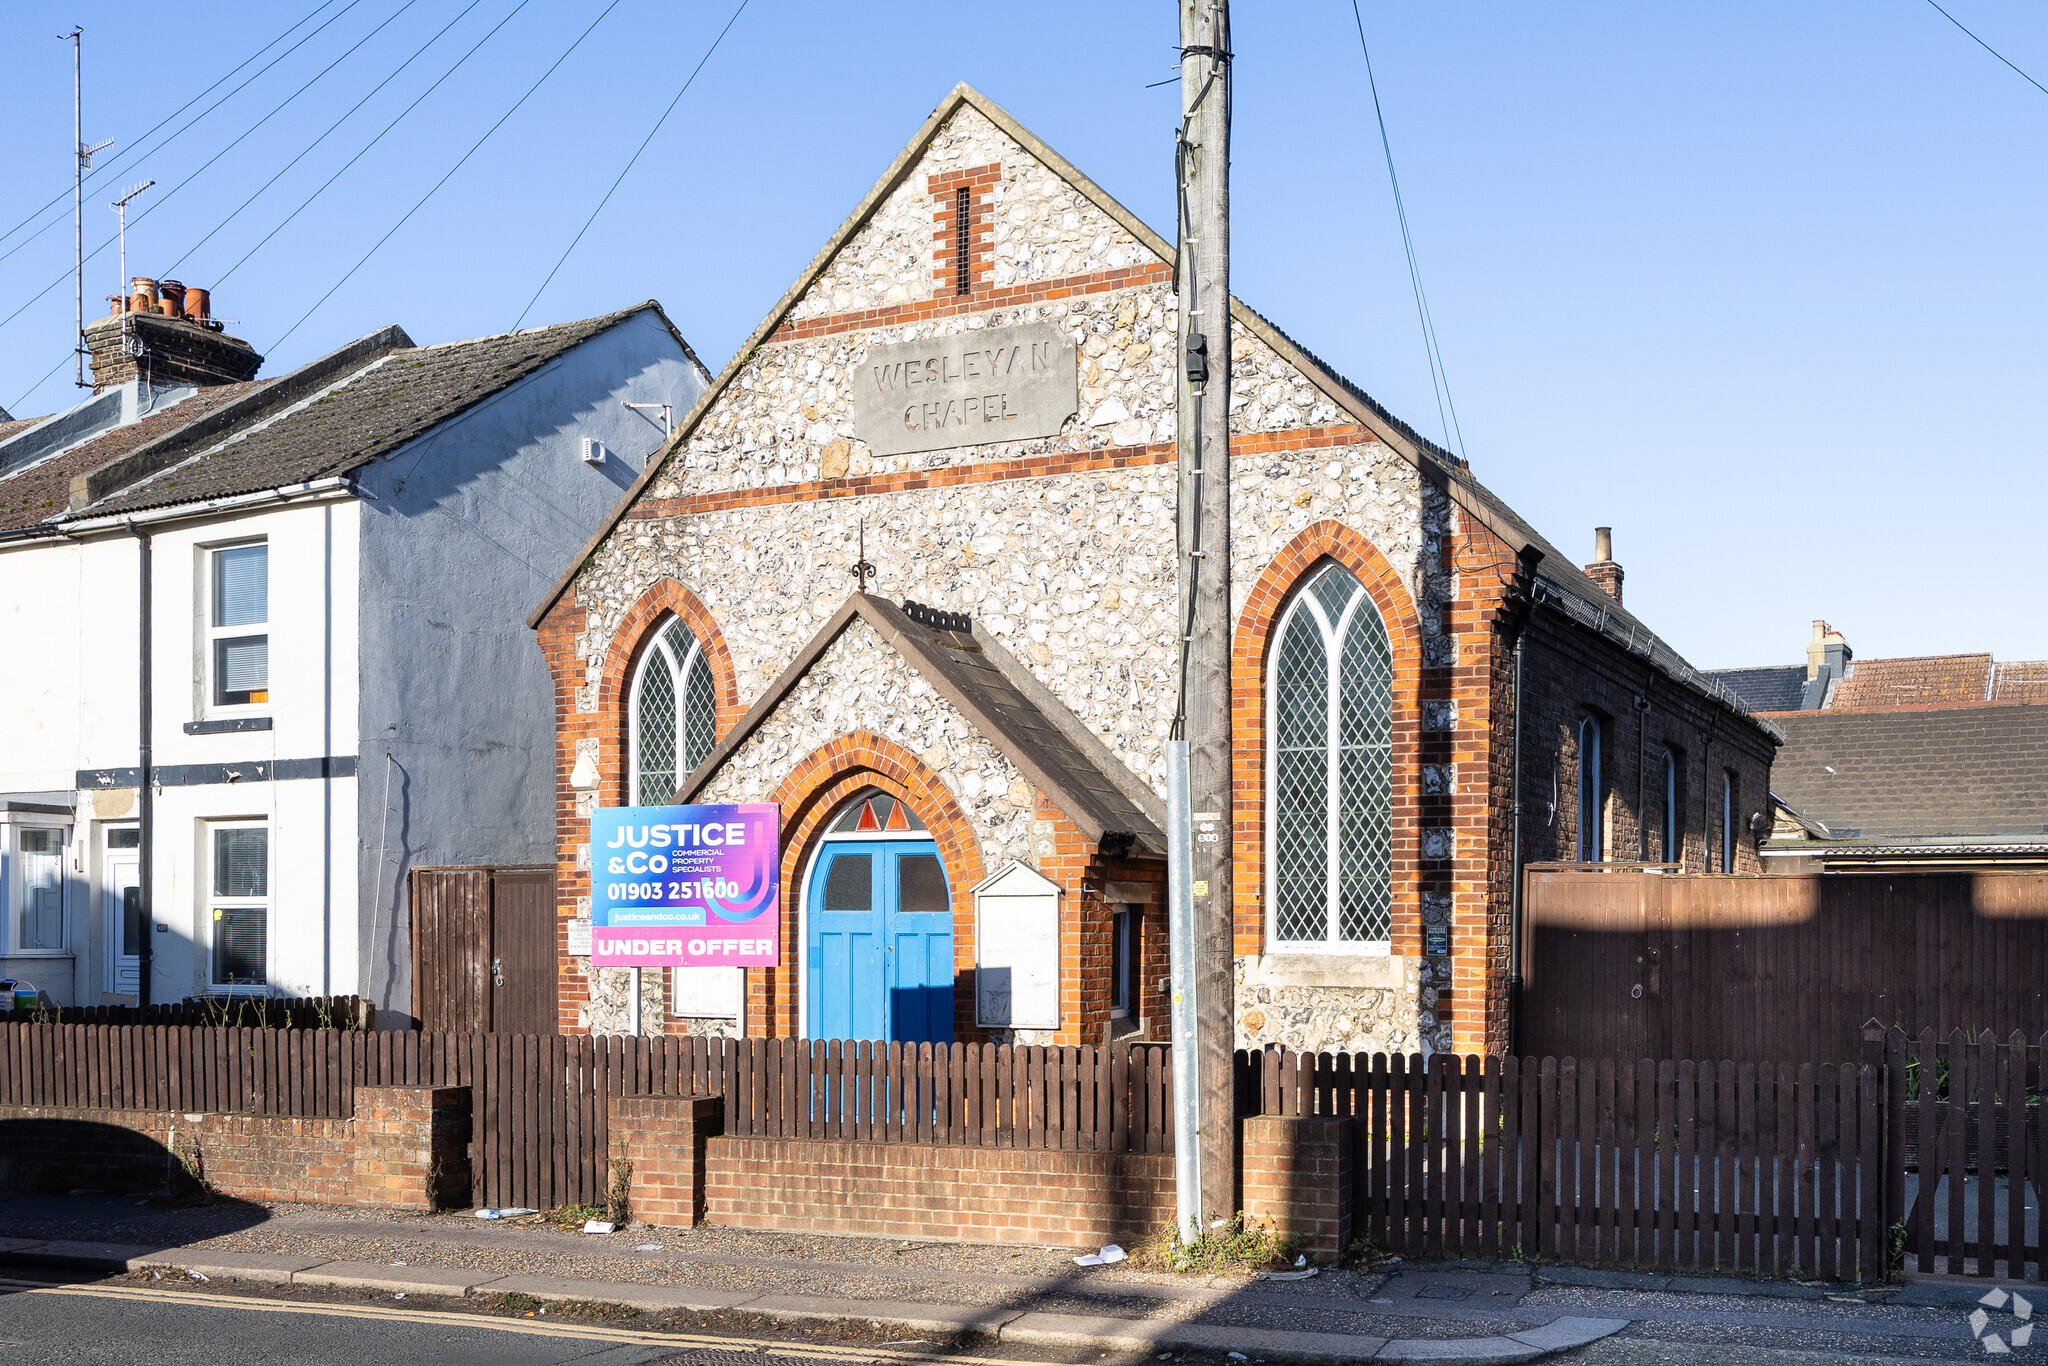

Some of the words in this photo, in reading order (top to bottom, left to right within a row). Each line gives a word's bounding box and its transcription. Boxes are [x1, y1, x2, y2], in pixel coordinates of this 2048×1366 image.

[873, 341, 1050, 392] WESLEYAN
[904, 393, 1018, 431] CHAPEL
[606, 823, 745, 848] JUSTICE
[671, 849, 725, 857] COMMERCIAL
[672, 857, 715, 865] PROPERTY
[608, 851, 668, 874] &Co
[672, 865, 722, 873] SPECIALISTS
[607, 882, 664, 900] 01903
[668, 881, 739, 899] 251600
[614, 912, 700, 923] justiceandco.co.uk
[598, 939, 683, 956] UNDER
[687, 938, 773, 956] OFFER
